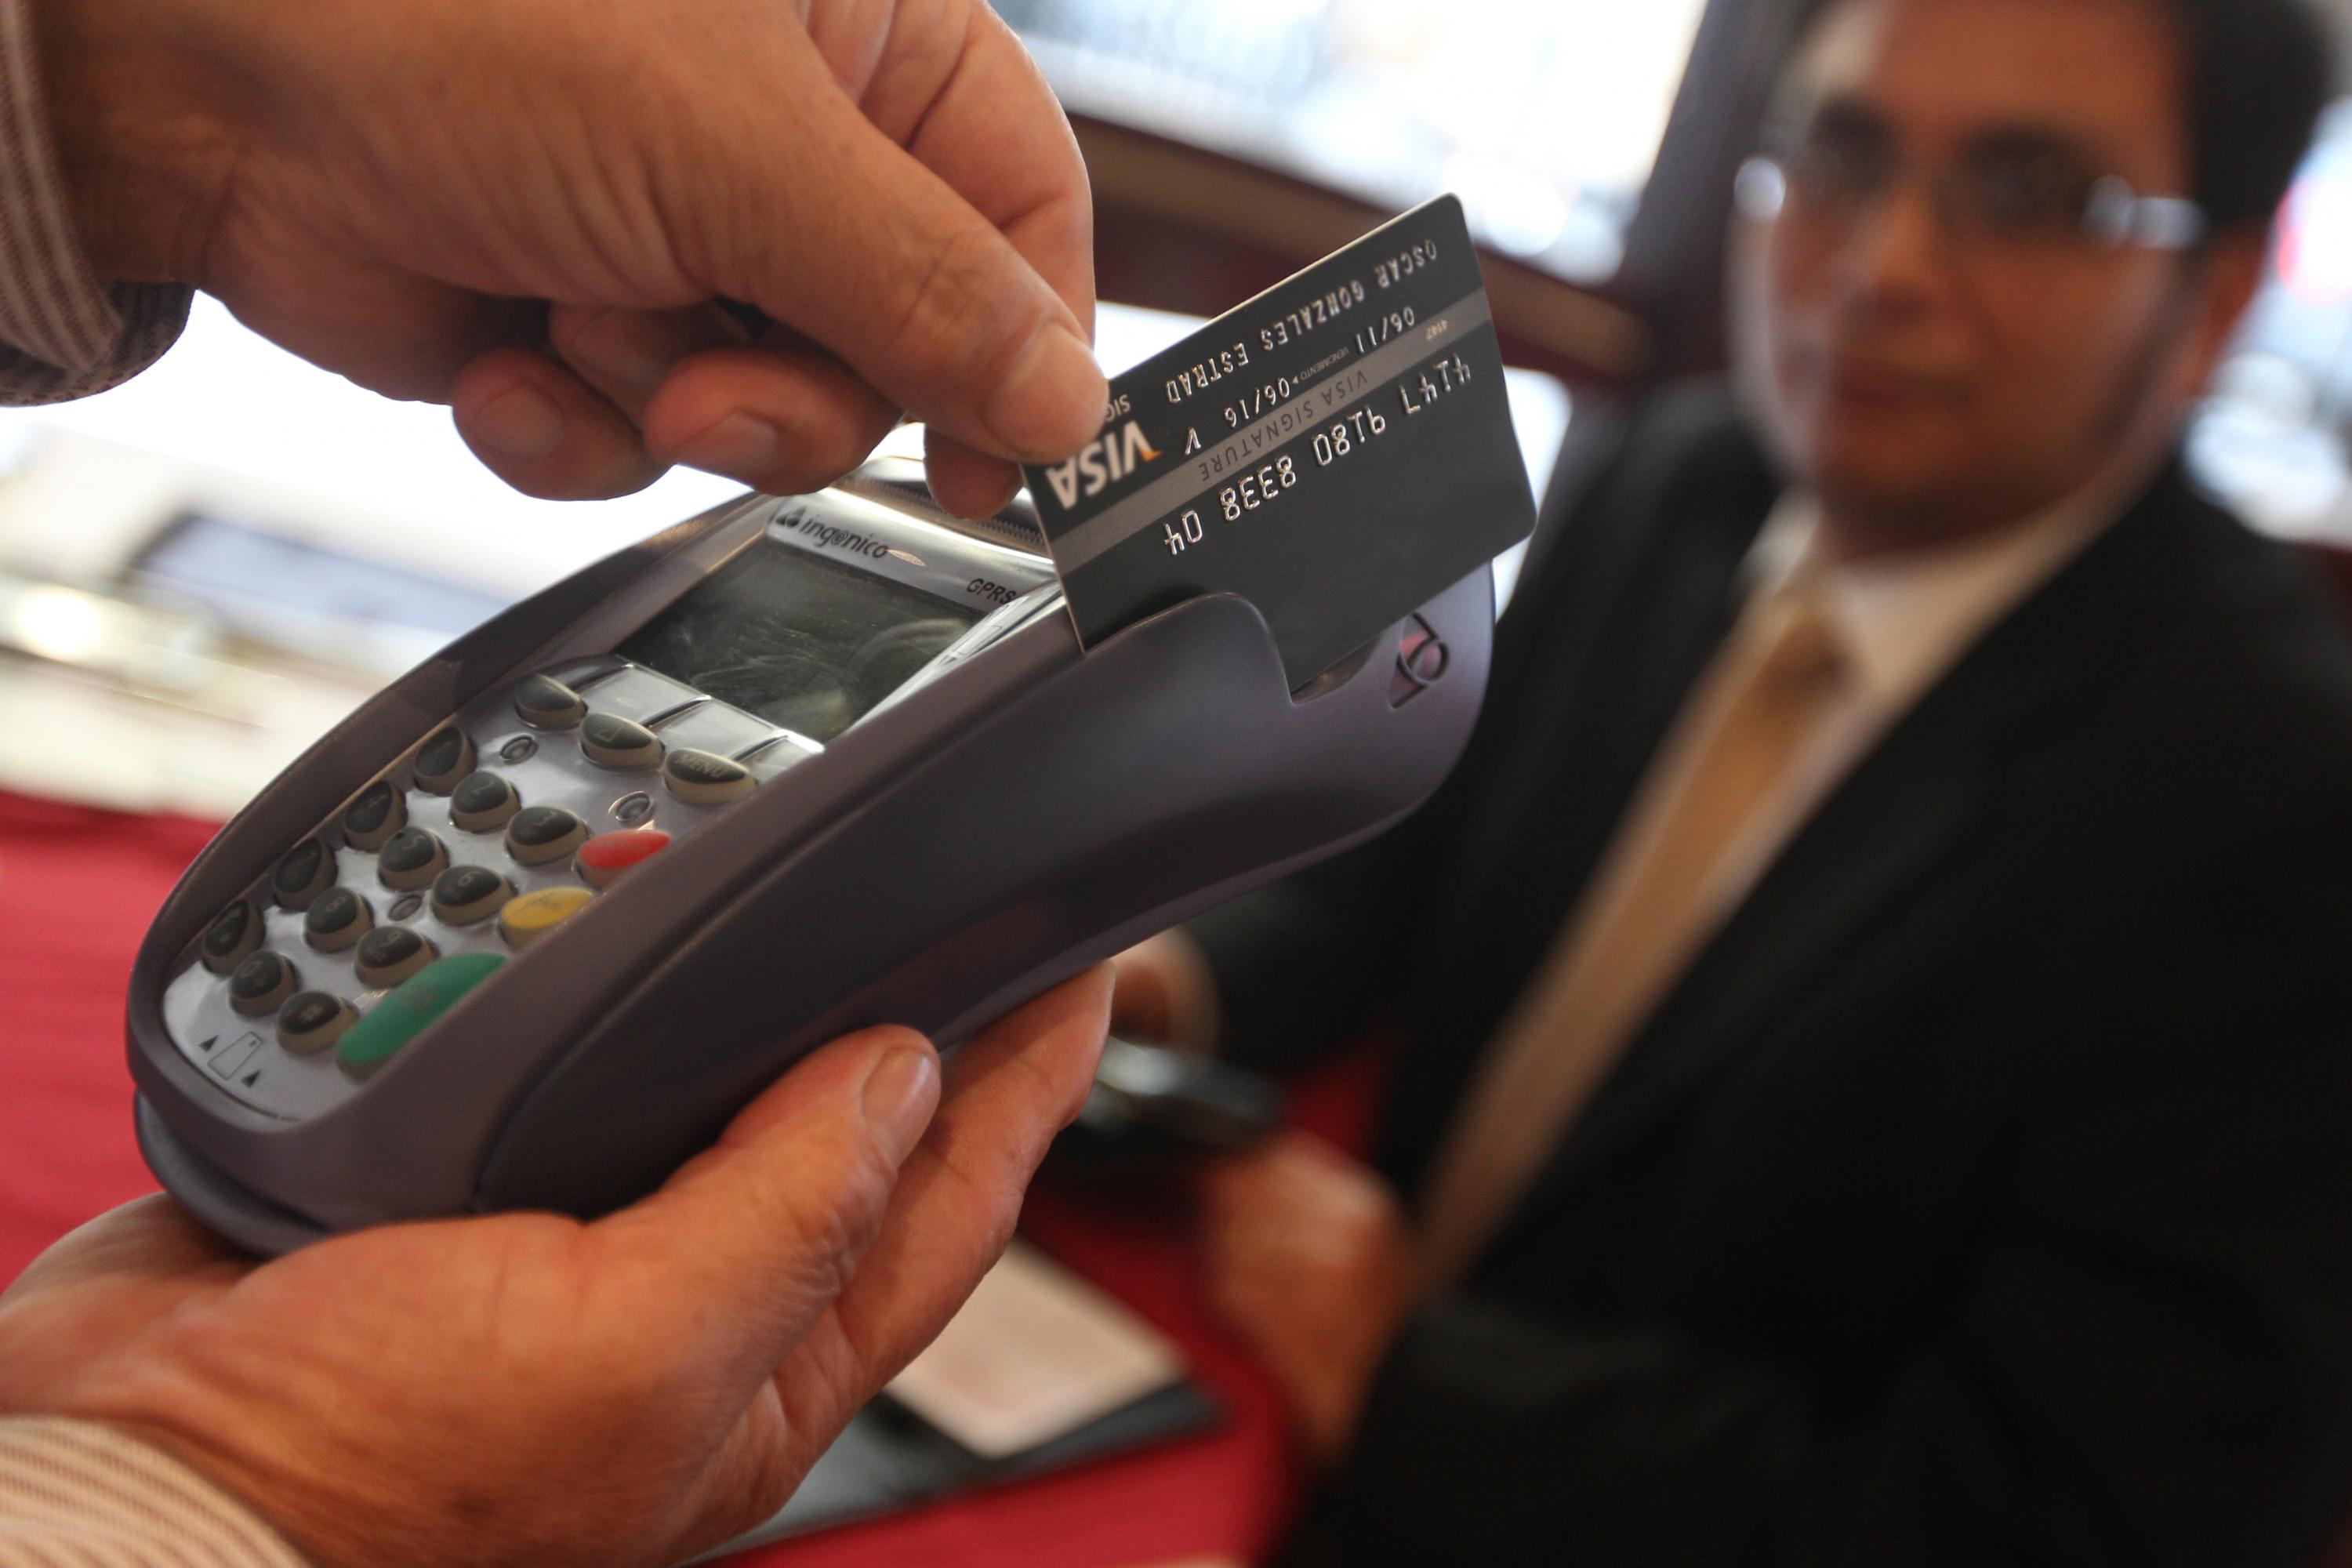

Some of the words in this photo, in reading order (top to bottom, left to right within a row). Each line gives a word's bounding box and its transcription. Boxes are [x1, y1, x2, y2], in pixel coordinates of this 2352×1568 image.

[1374, 238, 1438, 289] OSCAR
[1260, 285, 1366, 352] GONZALES
[1355, 305, 1416, 355] 06/11
[1165, 342, 1249, 404] ESTRAD
[1325, 370, 1369, 405] VISA
[1400, 354, 1472, 415] 4147
[1223, 377, 1291, 430] 06/16
[1185, 426, 1202, 455] V
[1197, 401, 1315, 481] SIGNATURE
[1312, 405, 1386, 467] 9180
[1045, 420, 1160, 510] VISA
[1220, 456, 1297, 522] 8338
[1163, 509, 1203, 556] 04
[967, 578, 1018, 605] GPRS
[677, 754, 728, 778] MENU
[458, 870, 481, 886] 6
